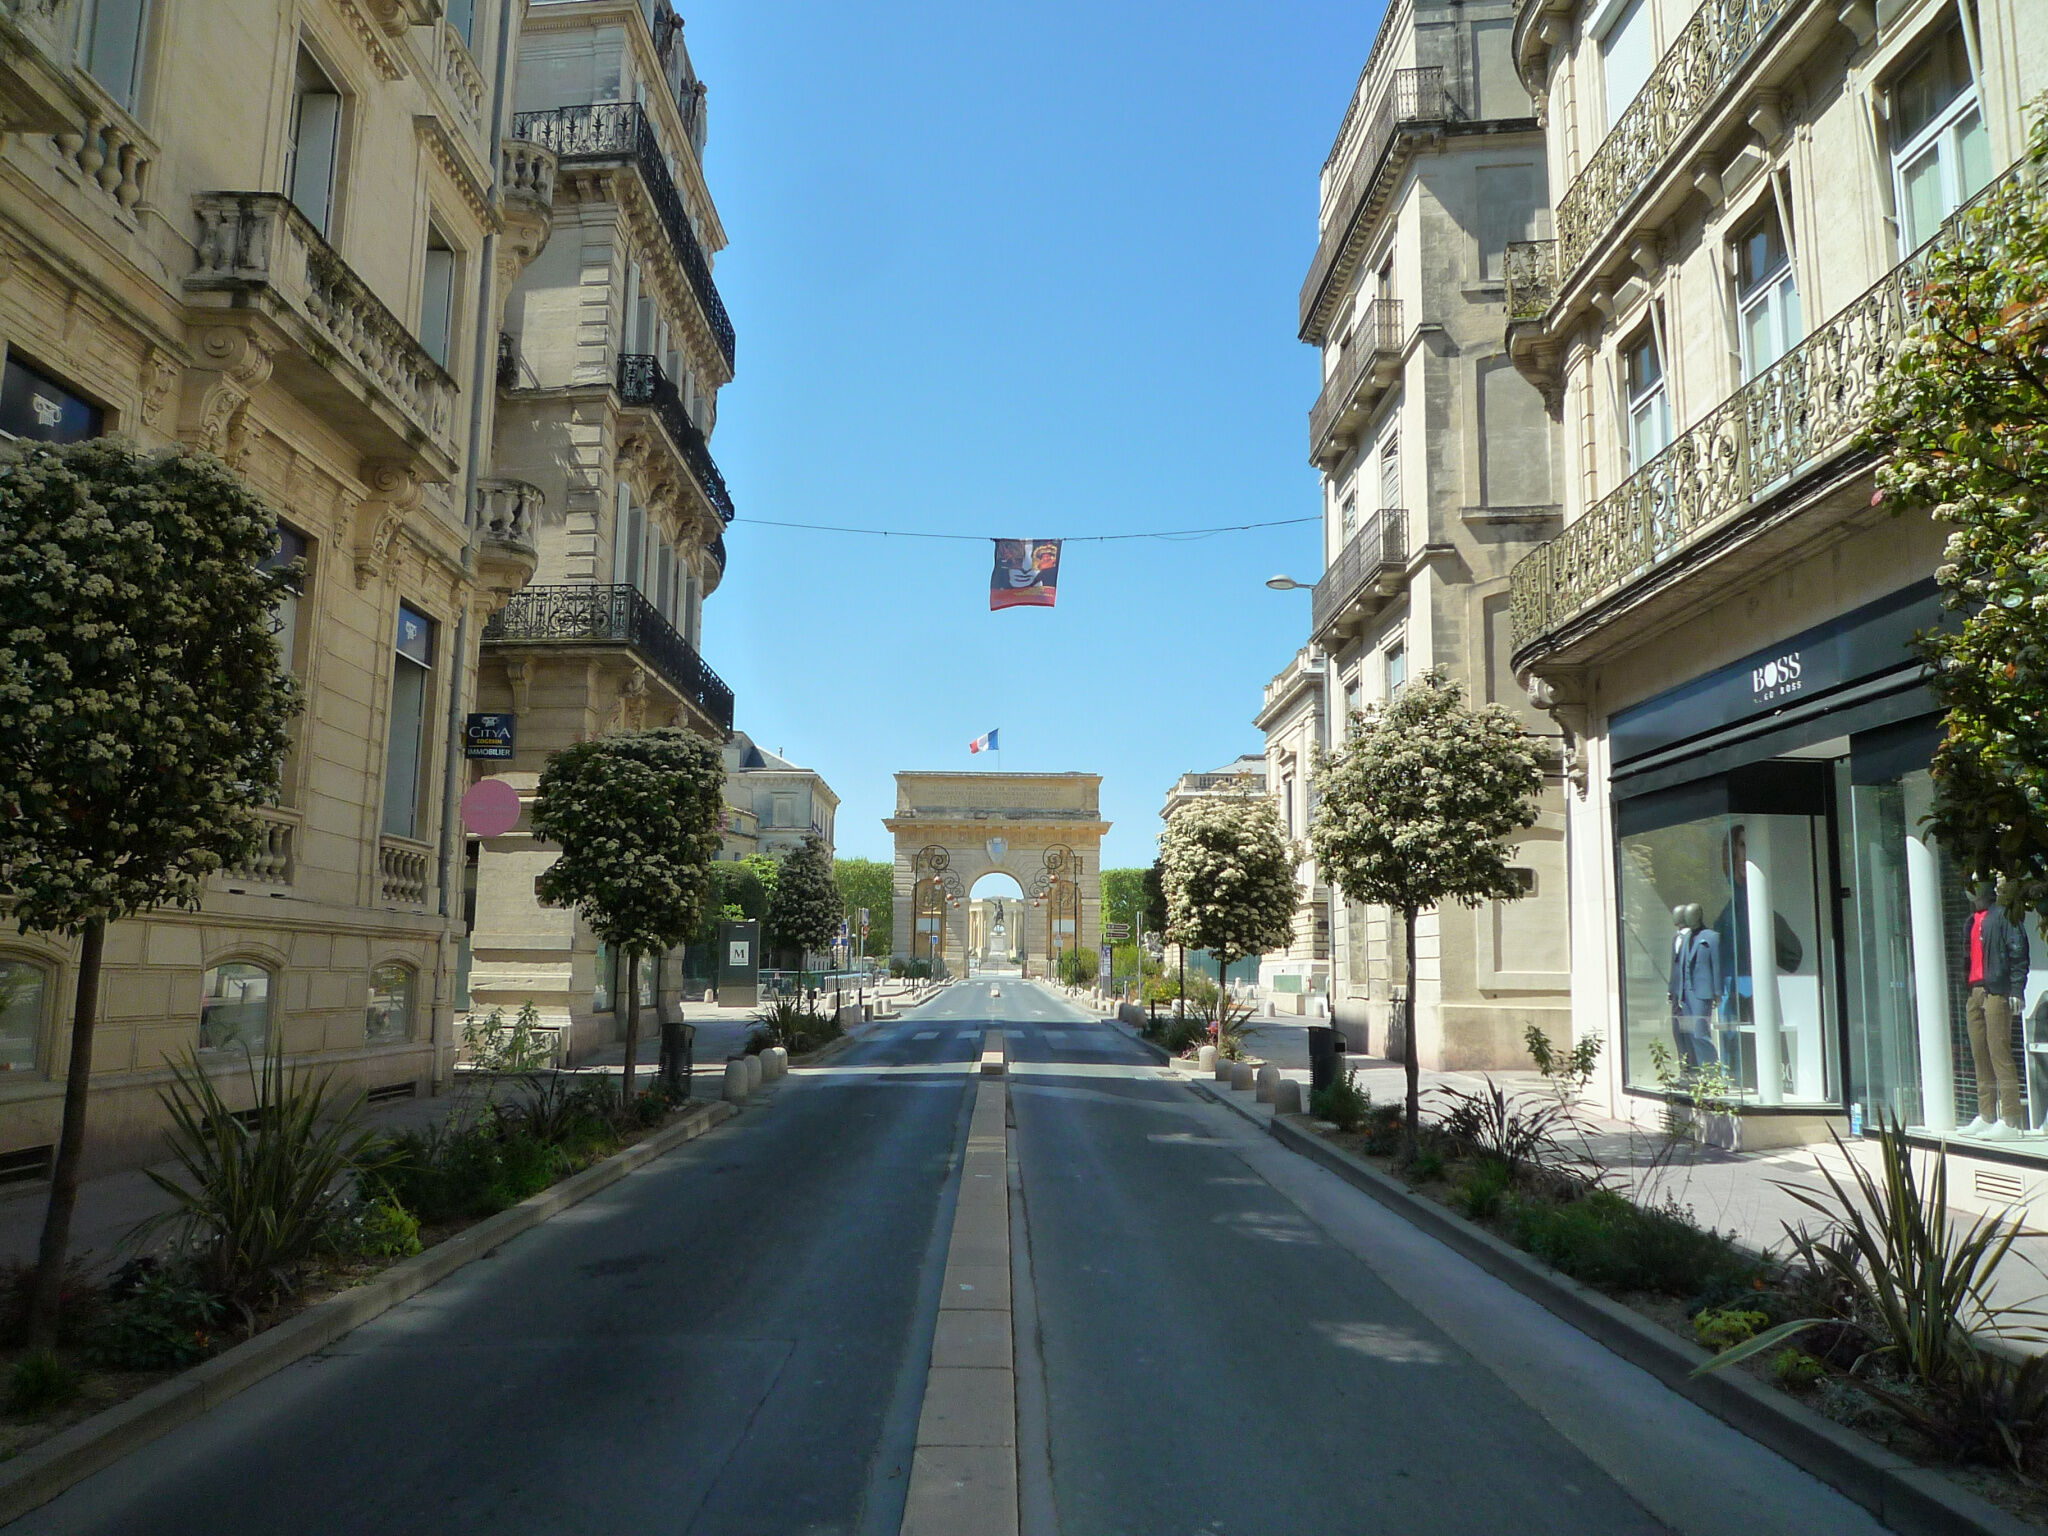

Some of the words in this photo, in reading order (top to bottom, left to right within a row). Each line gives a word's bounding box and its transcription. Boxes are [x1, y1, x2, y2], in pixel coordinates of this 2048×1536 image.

[1753, 652, 1801, 692] BOSS
[1780, 681, 1801, 695] BOSS
[467, 748, 511, 756] IMMOBILIER
[733, 949, 745, 959] M
